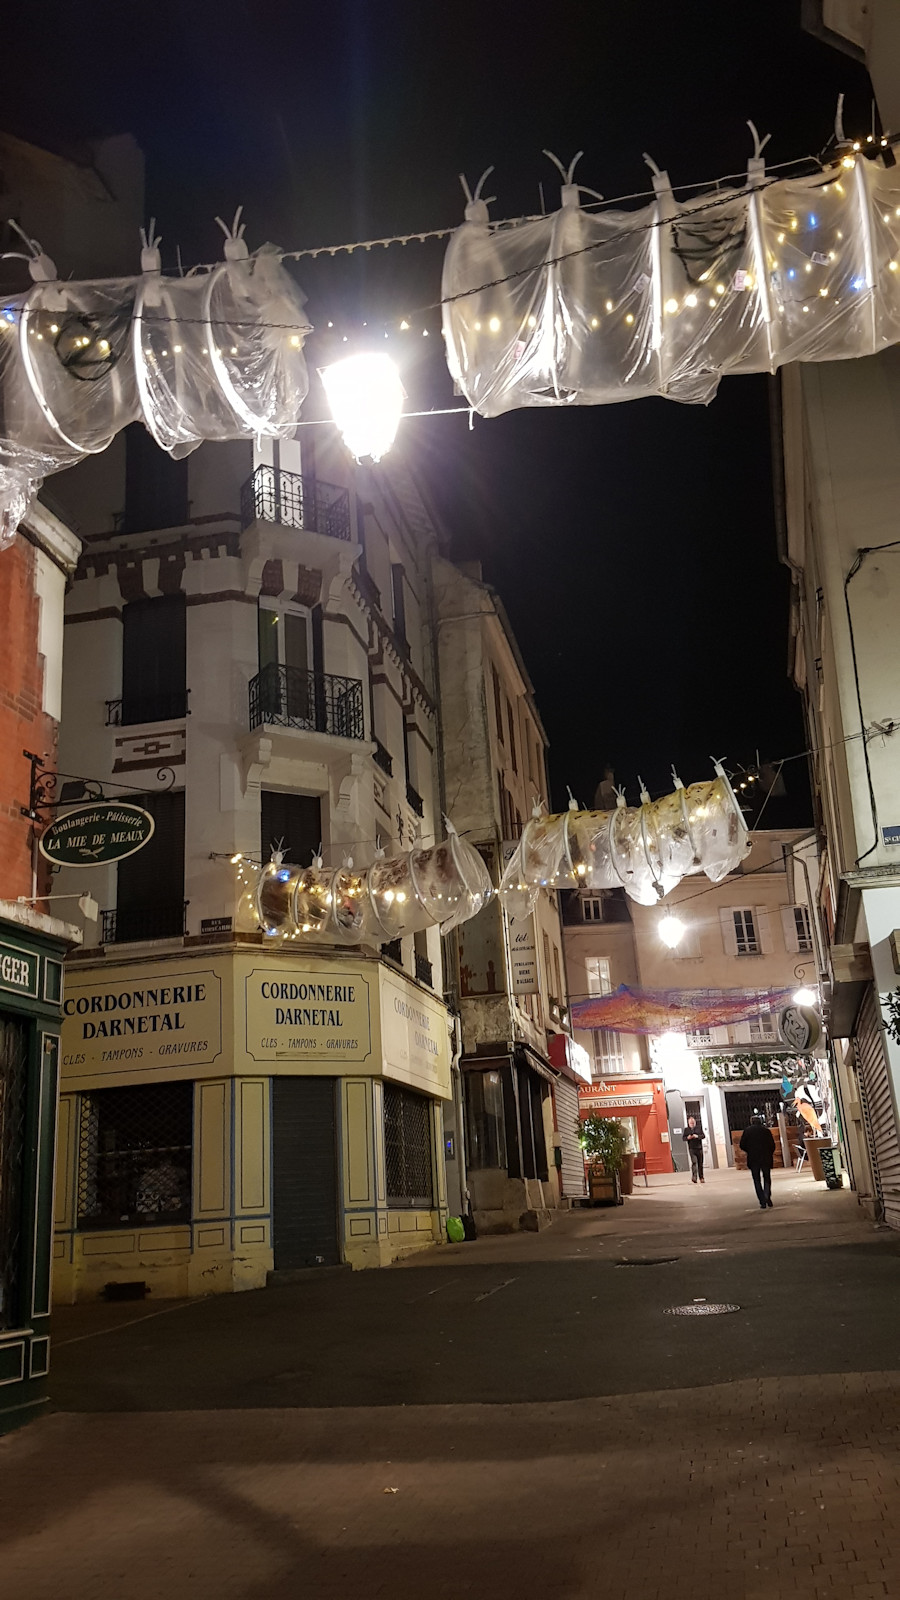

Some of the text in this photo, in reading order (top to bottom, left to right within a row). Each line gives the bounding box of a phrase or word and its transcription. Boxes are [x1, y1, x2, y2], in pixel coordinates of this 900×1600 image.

[52, 813, 100, 835] Boulangerie
[106, 811, 143, 828] Pâtisserie
[47, 829, 145, 851] LA MIE DE MEAUX
[0, 954, 29, 987] GER
[63, 983, 207, 1016] CORDONNERIE
[261, 981, 356, 1003] CORDONNERIE
[82, 1012, 186, 1040] DARNETAL
[275, 1008, 343, 1027] DARNETAL
[394, 997, 430, 1031] CORDONNERIE
[63, 1040, 208, 1066] CLES TAMPONS GRAVURES
[261, 1037, 358, 1049] CLES TAMPONS GRAVURES
[414, 1031, 439, 1056] DARNETAL
[579, 1084, 617, 1094] AURANT
[592, 1098, 642, 1108] RESTAURANT
